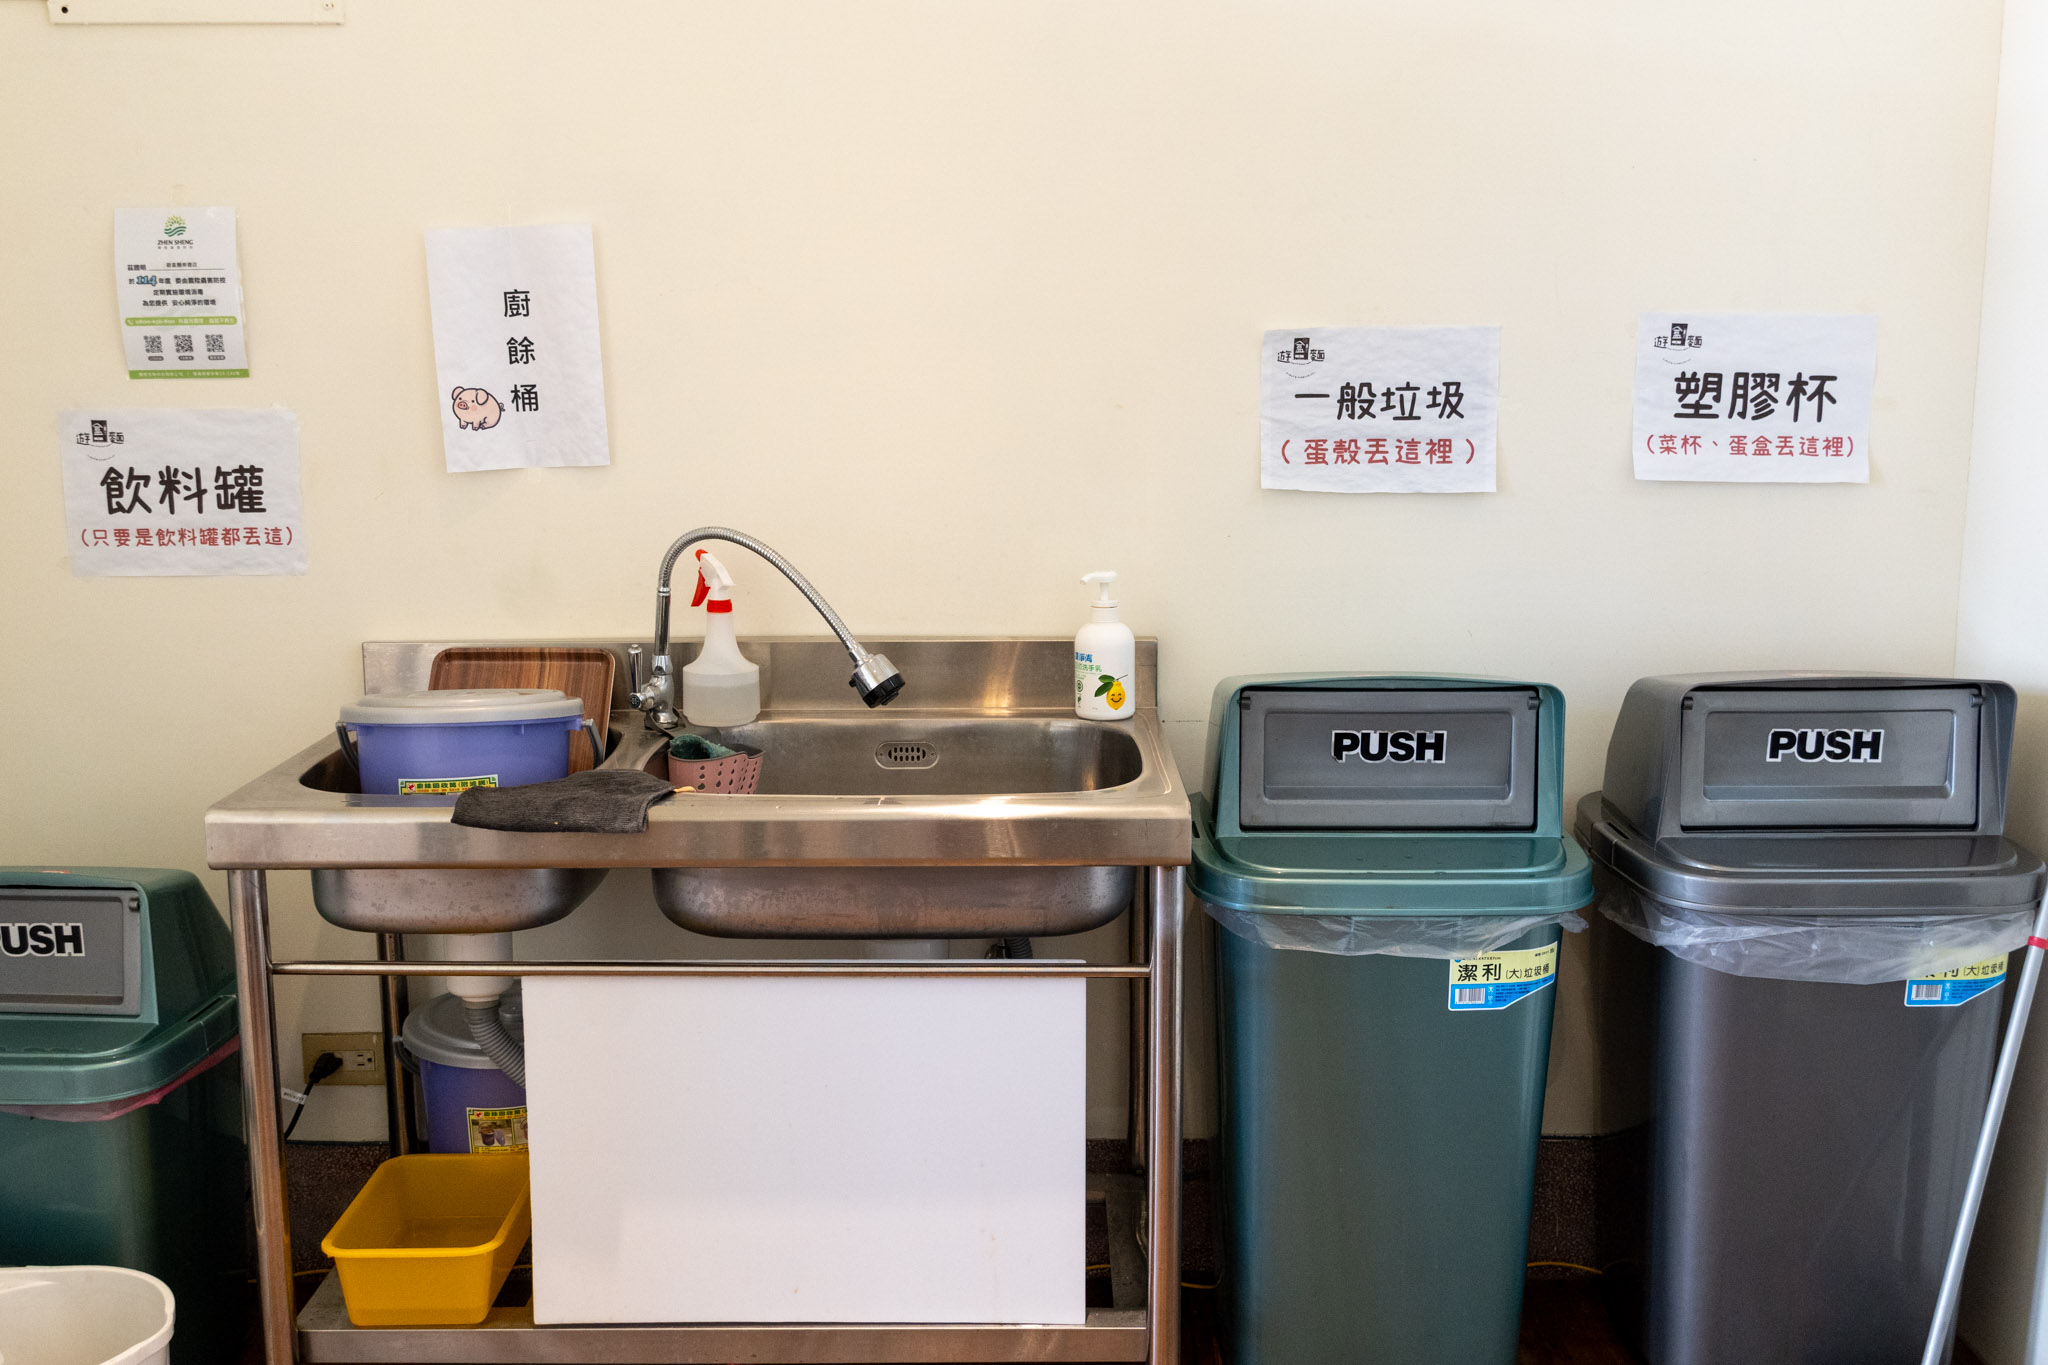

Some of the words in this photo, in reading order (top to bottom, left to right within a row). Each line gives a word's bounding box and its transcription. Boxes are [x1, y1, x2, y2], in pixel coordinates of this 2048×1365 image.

[136, 275, 157, 287] 114
[503, 289, 539, 412] 廚餘桶
[1294, 381, 1465, 421] 一般垃圾
[1673, 371, 1838, 423] 塑膠杯
[1646, 434, 1854, 458] (菜杯、蛋盒丟這裡)
[100, 464, 267, 515] 飲料罐
[81, 526, 293, 547] (只要是飲料罐都丟這)
[1332, 731, 1446, 762] PUSH
[1766, 729, 1884, 762] PUSH
[0, 923, 84, 956] USH
